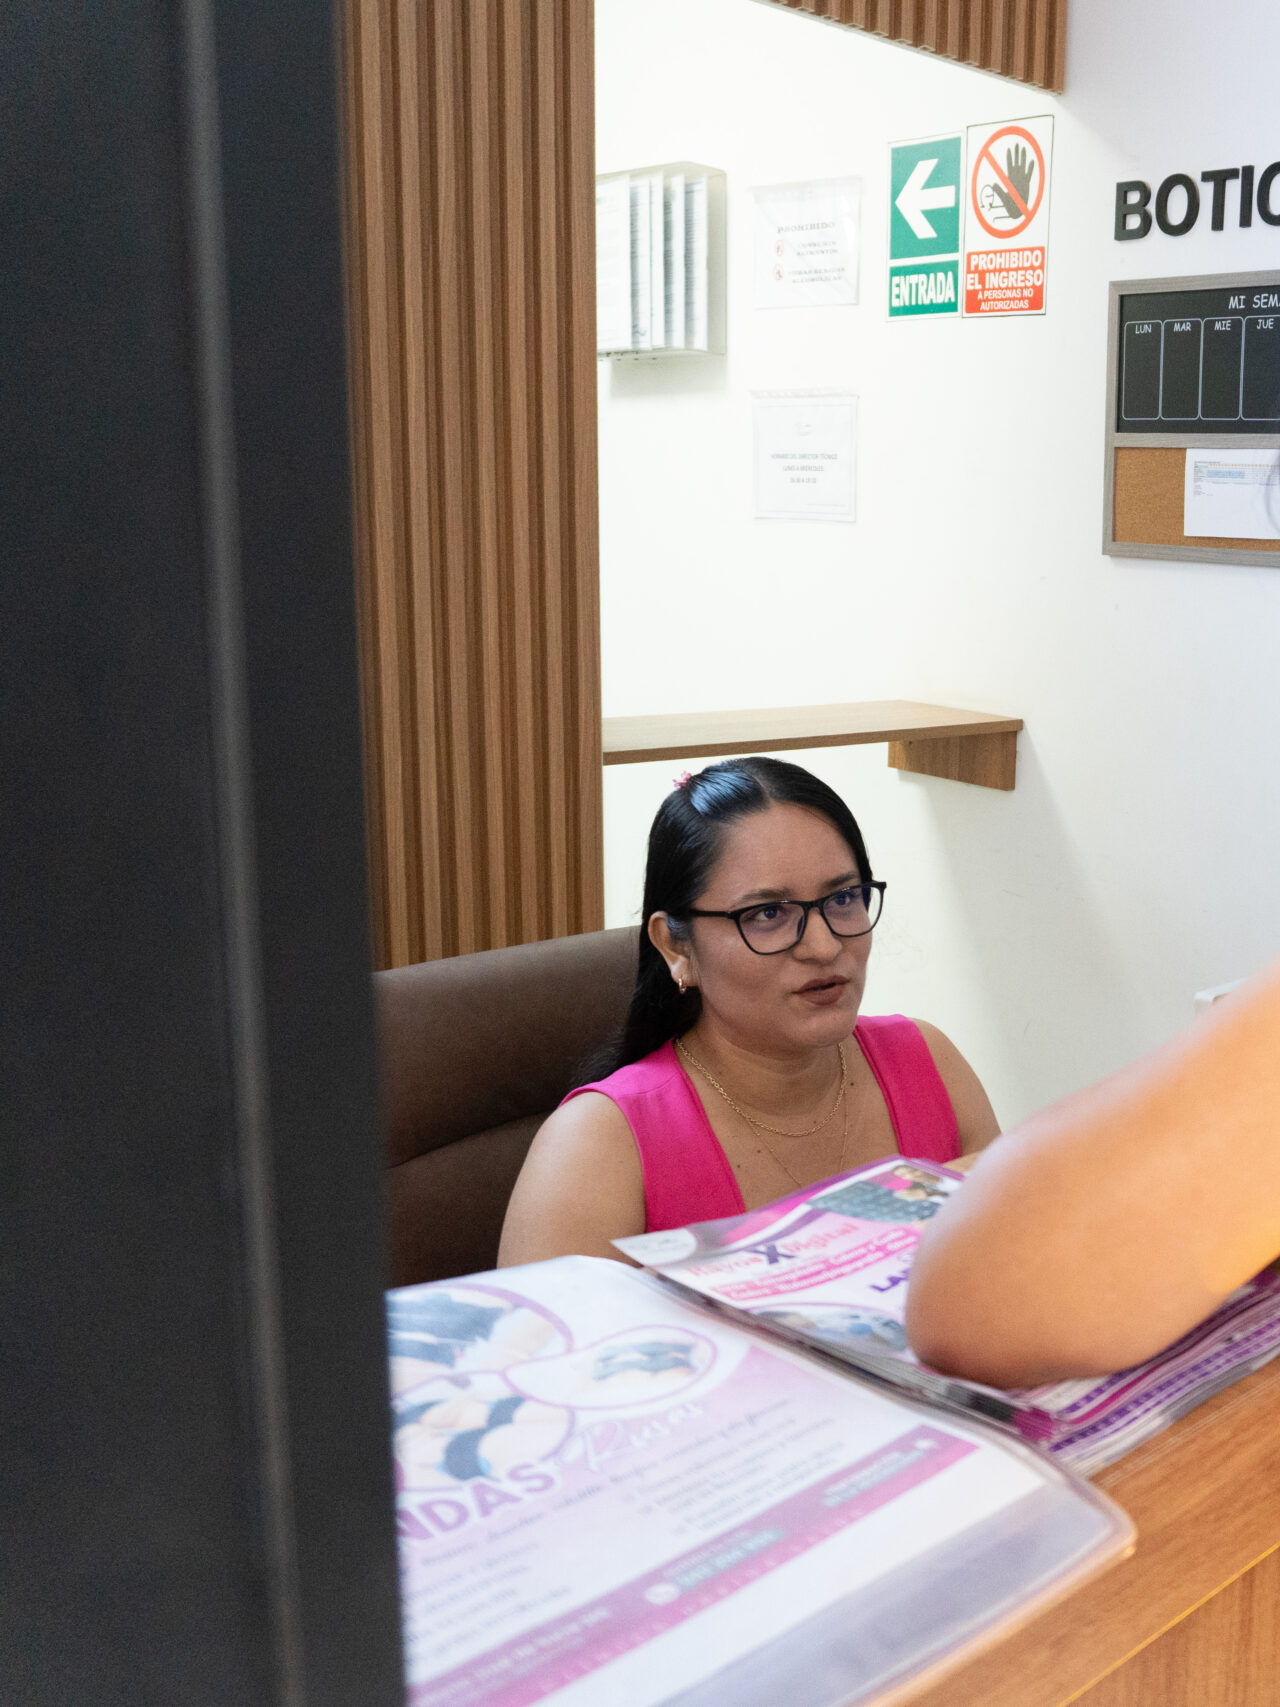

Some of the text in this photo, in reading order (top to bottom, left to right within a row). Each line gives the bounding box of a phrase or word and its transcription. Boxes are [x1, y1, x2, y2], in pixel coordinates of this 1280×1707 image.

[970, 249, 1042, 271] PROHIBIDO
[966, 269, 1044, 290] EL INGRESO
[891, 271, 956, 307] ENTRADA
[977, 287, 1034, 300] A PERSONAS NO
[980, 299, 1029, 311] AUTORIZADAS
[1228, 295, 1246, 310] MI
[1135, 323, 1152, 335] LUN
[1173, 321, 1192, 332] MAR
[1214, 319, 1232, 331] MIE
[1256, 318, 1274, 329] JUE
